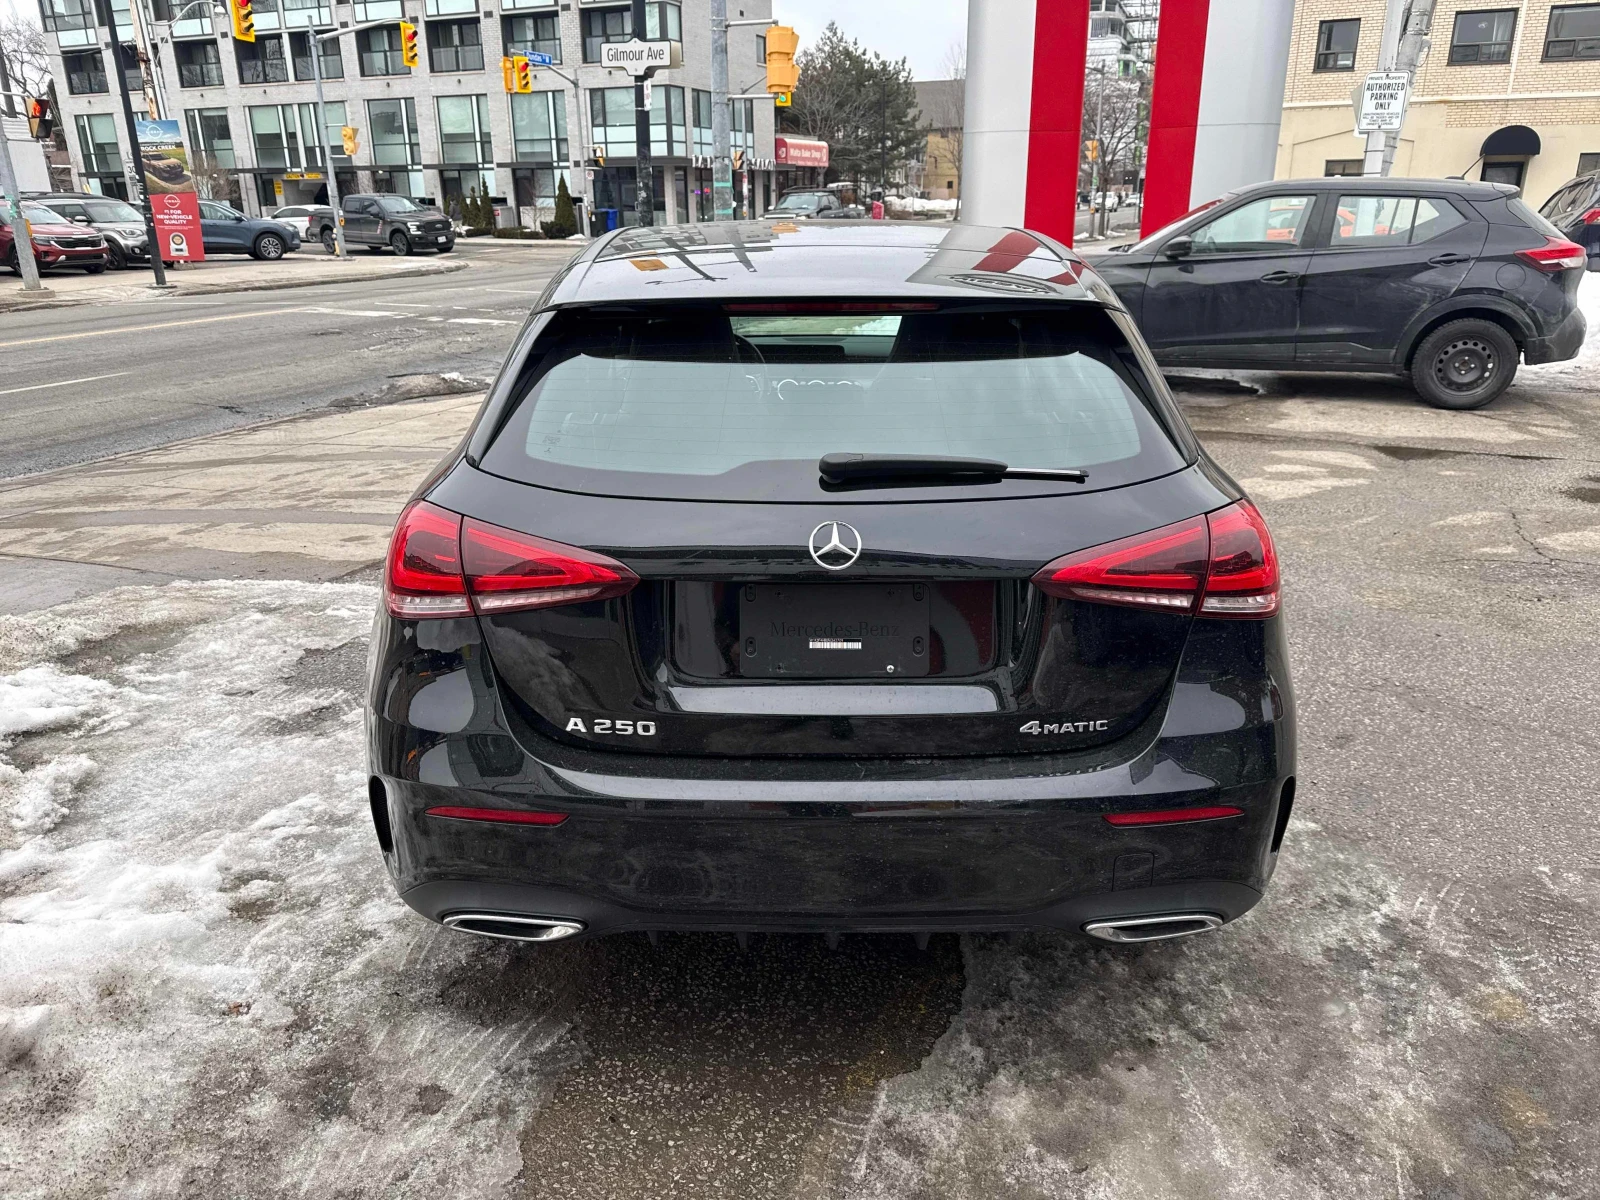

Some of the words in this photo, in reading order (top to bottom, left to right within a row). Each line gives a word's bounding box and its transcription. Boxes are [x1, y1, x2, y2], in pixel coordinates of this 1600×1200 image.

[607, 47, 644, 62] Gilmour
[647, 46, 664, 60] Ave
[1366, 83, 1405, 91] AUTHORIZED
[1370, 92, 1398, 101] PARKING
[1375, 101, 1391, 110] ONLY
[770, 621, 900, 637] Mercedes-Benz
[565, 717, 588, 733] A
[593, 719, 657, 736] 250
[1019, 720, 1109, 735] 4MATIC
